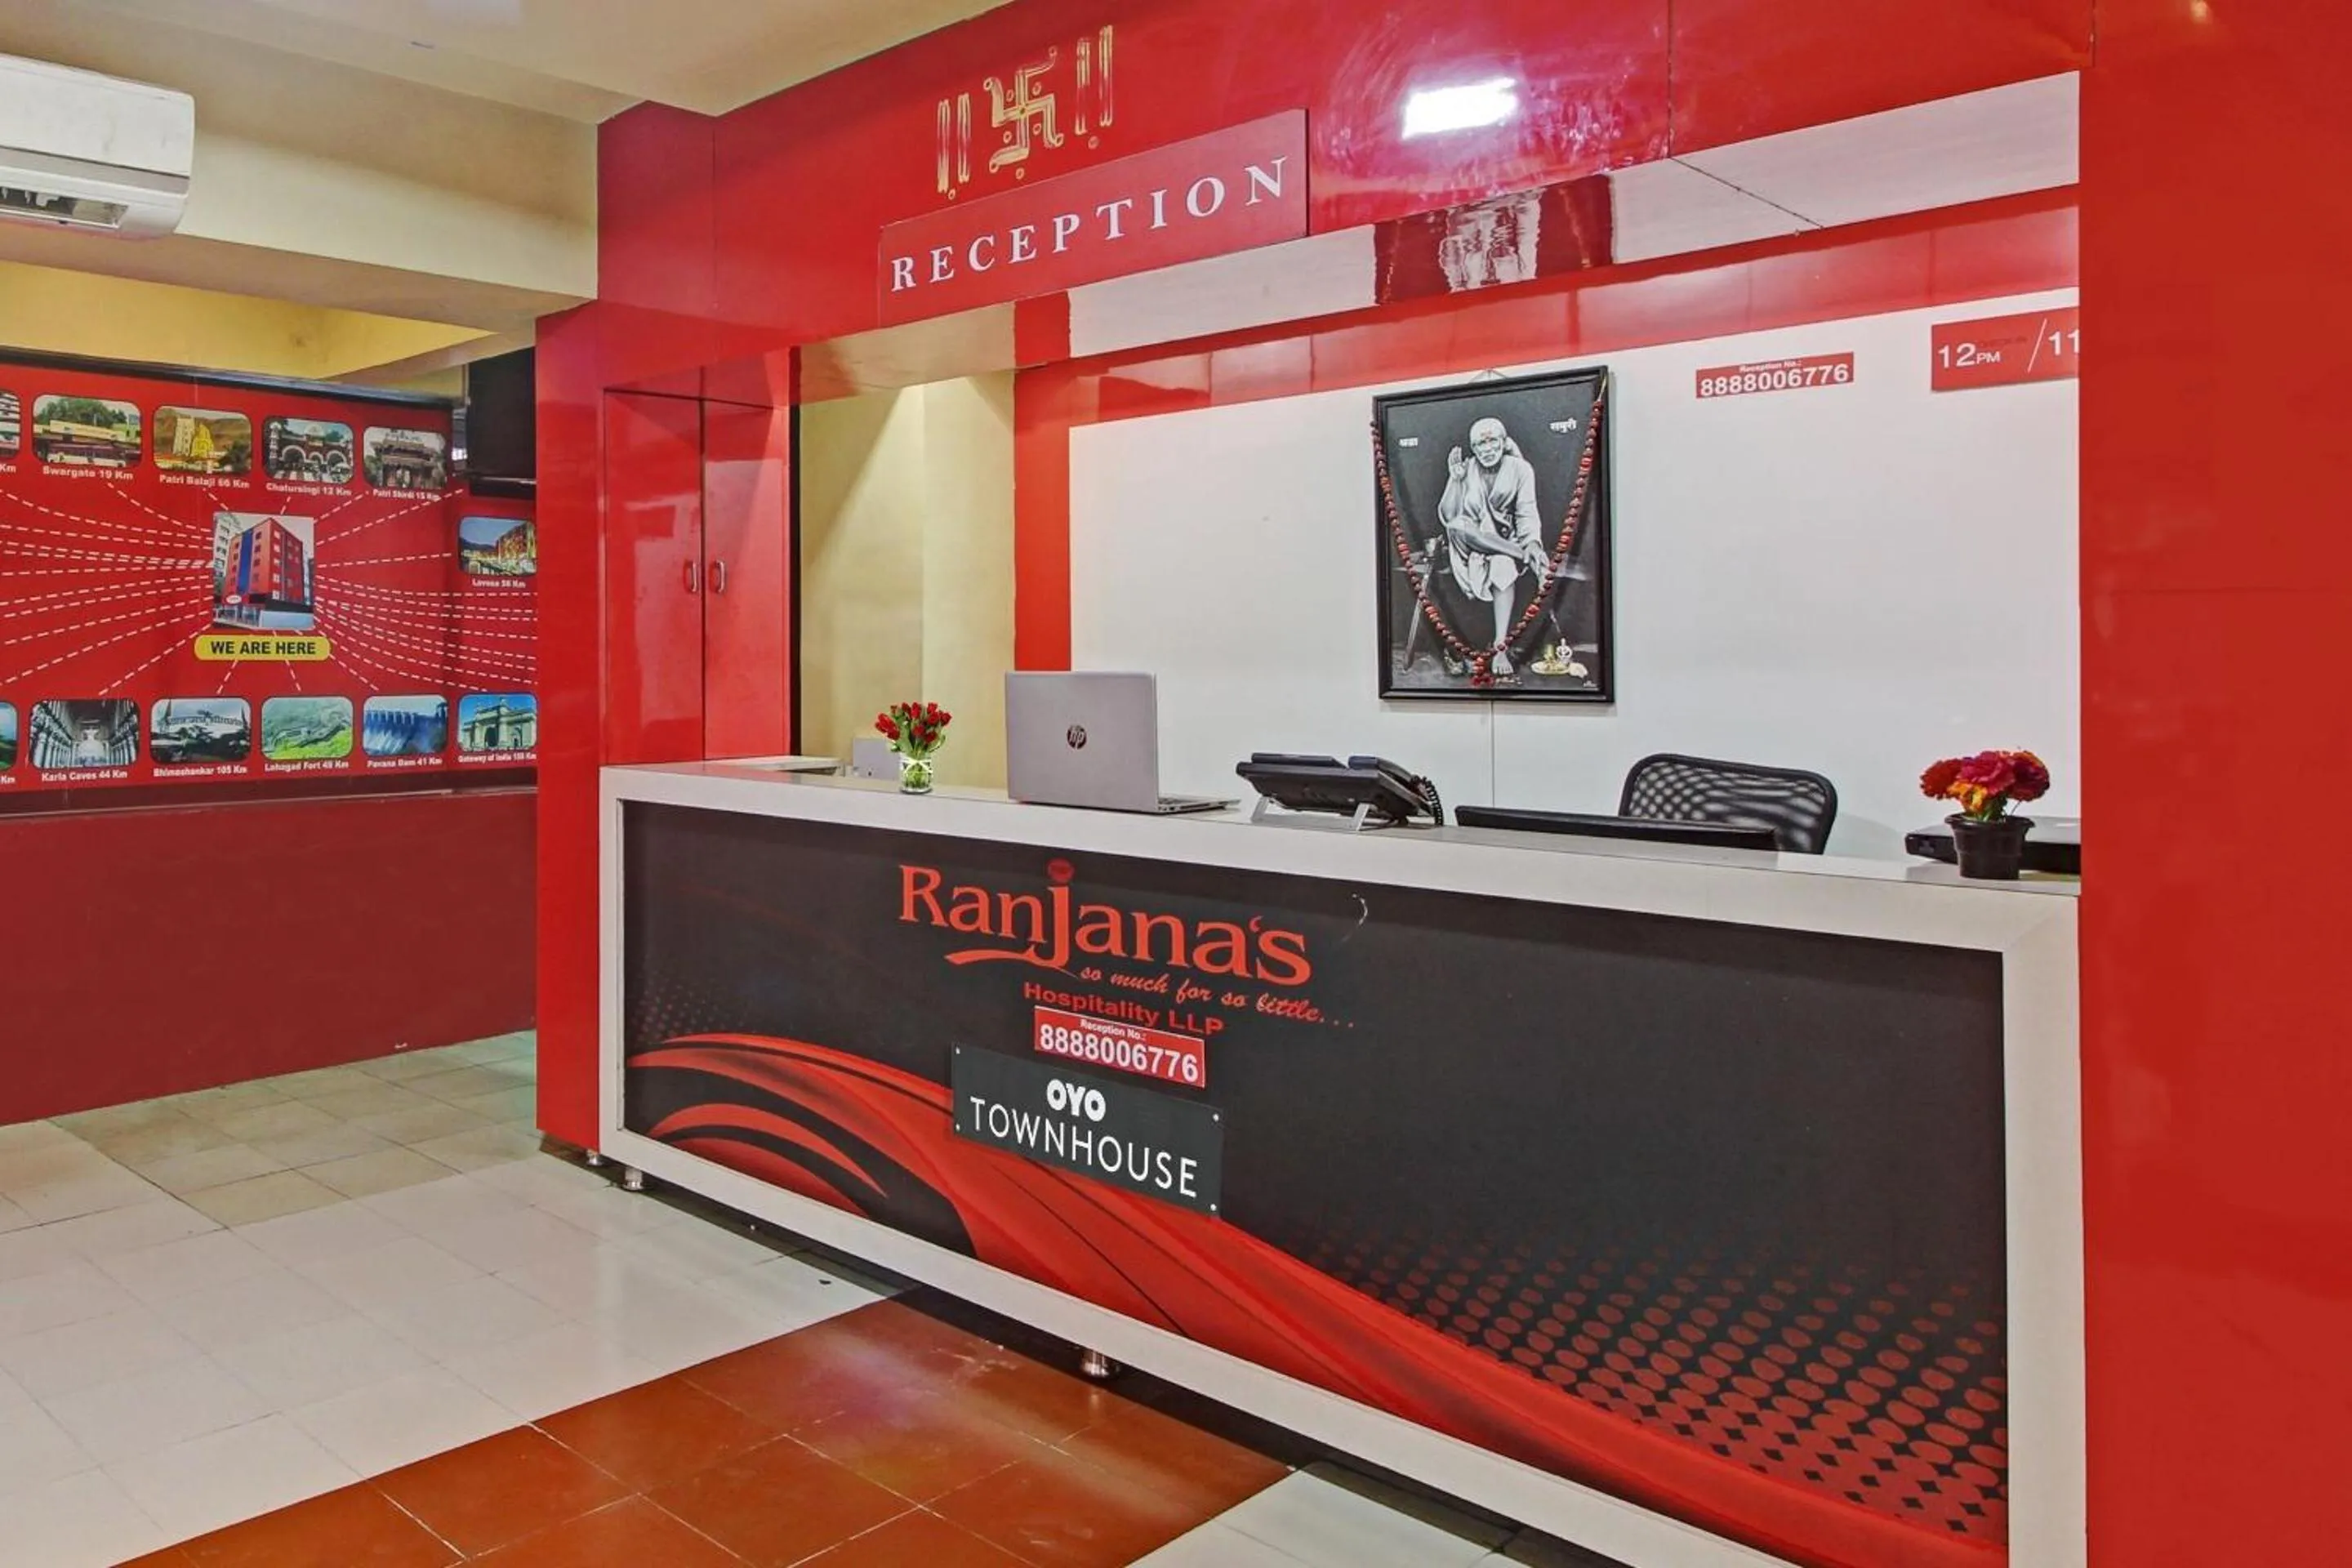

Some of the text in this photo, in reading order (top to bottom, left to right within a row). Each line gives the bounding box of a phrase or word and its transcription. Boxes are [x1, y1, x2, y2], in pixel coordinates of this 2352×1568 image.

[891, 155, 1289, 292] RECEPTION
[1740, 363, 1783, 372] Reception
[1700, 363, 1849, 396] 8888006776
[42, 466, 96, 479] Swargate
[115, 470, 133, 480] Km
[233, 479, 250, 488] Km
[336, 488, 352, 496] Km
[211, 641, 316, 654] WE ARE HERE
[1067, 725, 1086, 748] hp
[233, 764, 247, 773] Km
[335, 760, 350, 768] Km
[69, 772, 97, 781] Caves
[112, 769, 127, 778] Km
[1080, 967, 1102, 981] so
[1111, 973, 1169, 994] much
[1176, 979, 1212, 1004] for
[1221, 991, 1247, 1007] so
[1024, 982, 1223, 1036] Hospitality LLP
[1080, 1018, 1126, 1038] Reception
[1040, 1023, 1199, 1083] 8888006776
[1047, 1079, 1106, 1122] OYO
[970, 1096, 1197, 1198] TOWNHOUSE
